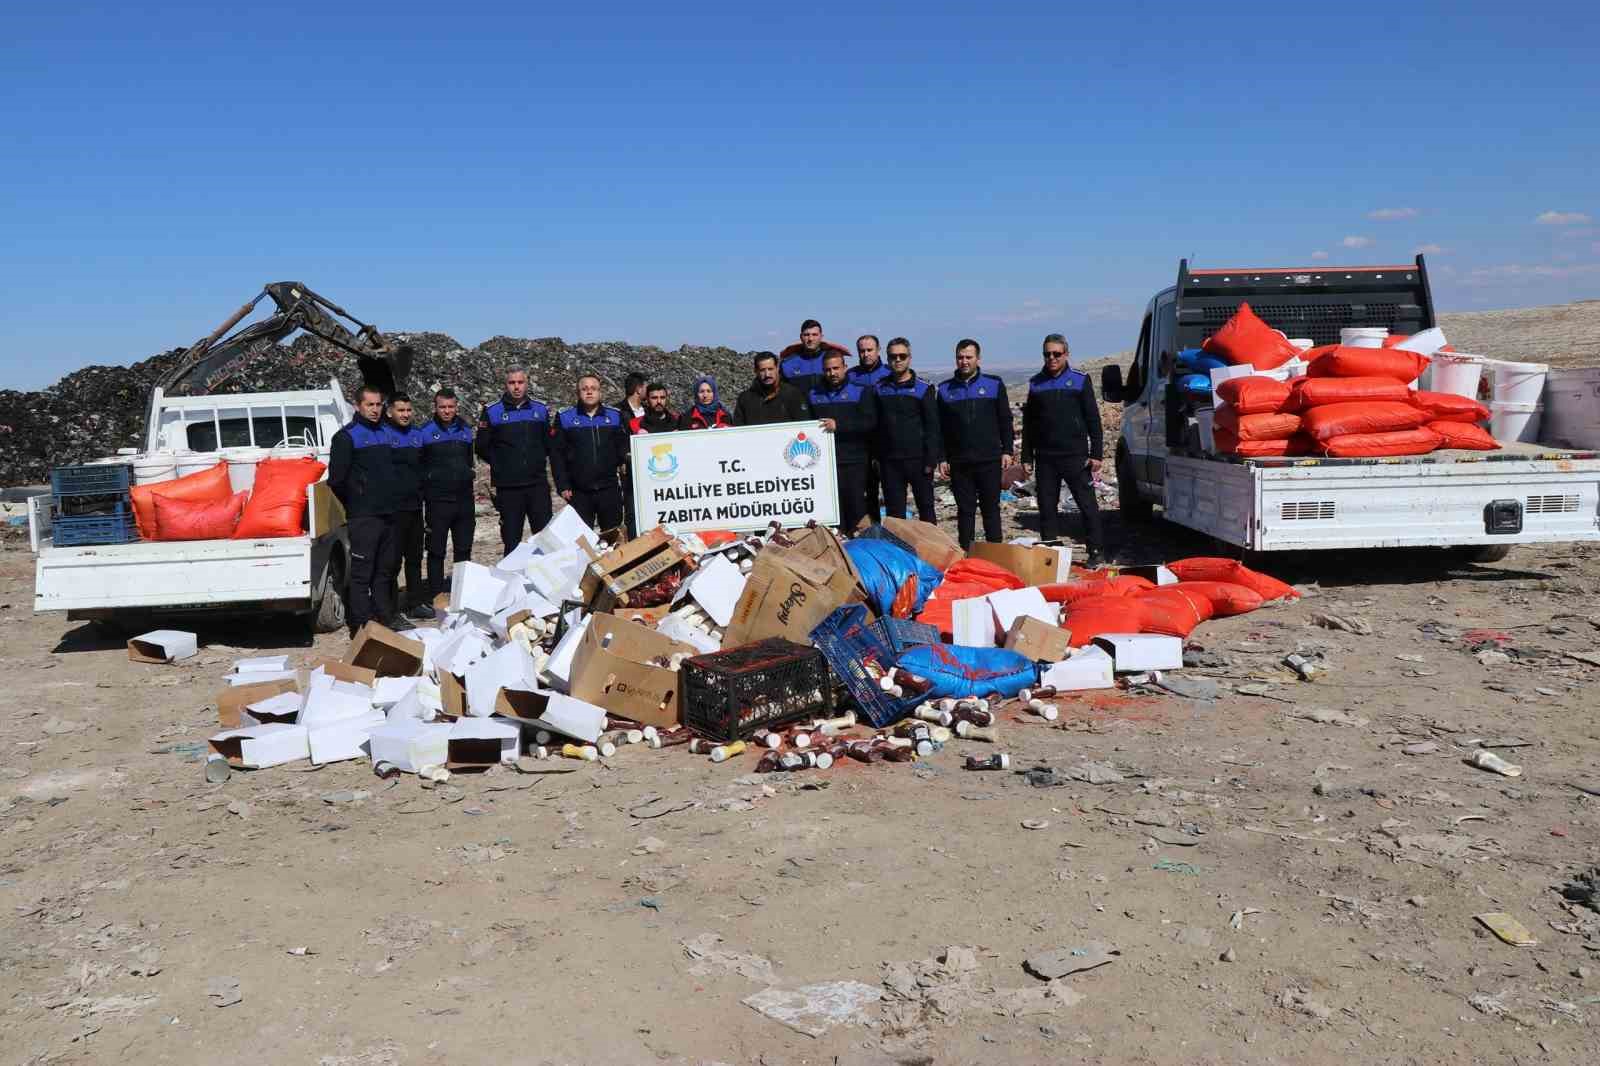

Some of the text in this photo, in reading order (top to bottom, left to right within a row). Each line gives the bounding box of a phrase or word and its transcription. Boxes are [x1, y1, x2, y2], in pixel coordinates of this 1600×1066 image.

[718, 460, 746, 474] T.C.
[653, 474, 815, 502] HALİLİYE BELEDİYESİ
[657, 498, 814, 524] ZABITA MÜDÜRLÜĞÜ
[776, 582, 807, 626] Sleepy
